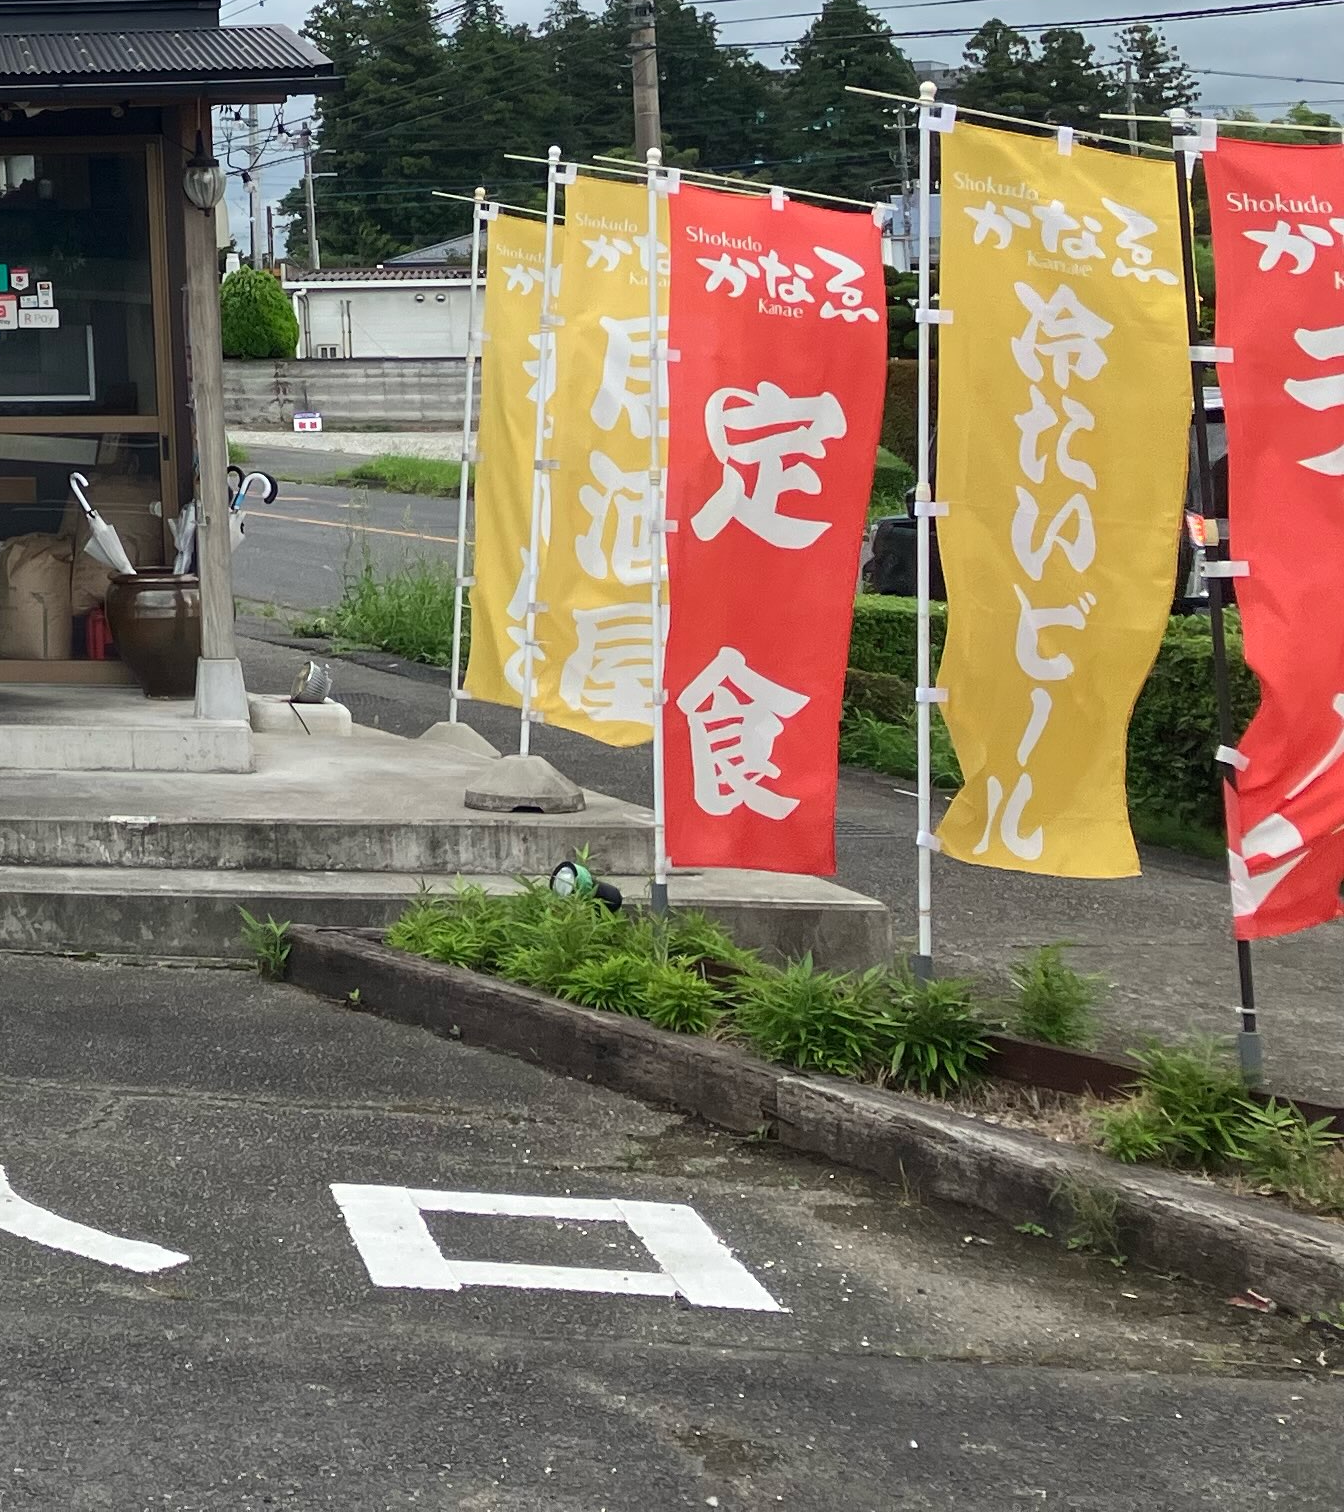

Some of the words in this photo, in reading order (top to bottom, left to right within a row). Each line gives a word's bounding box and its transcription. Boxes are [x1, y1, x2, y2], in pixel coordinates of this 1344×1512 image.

[953, 171, 1039, 201] Shokudo
[1225, 192, 1333, 214] Shokudo
[576, 212, 639, 233] Shokudo
[581, 233, 670, 273] かな
[685, 225, 763, 253] Shokudo
[963, 196, 1180, 286] かなゑ
[629, 272, 670, 286] Kaa
[695, 245, 880, 323] かなゑ
[758, 298, 804, 319] Kanae
[973, 280, 1115, 861] 冷たいビール
[676, 382, 848, 821] 定食
